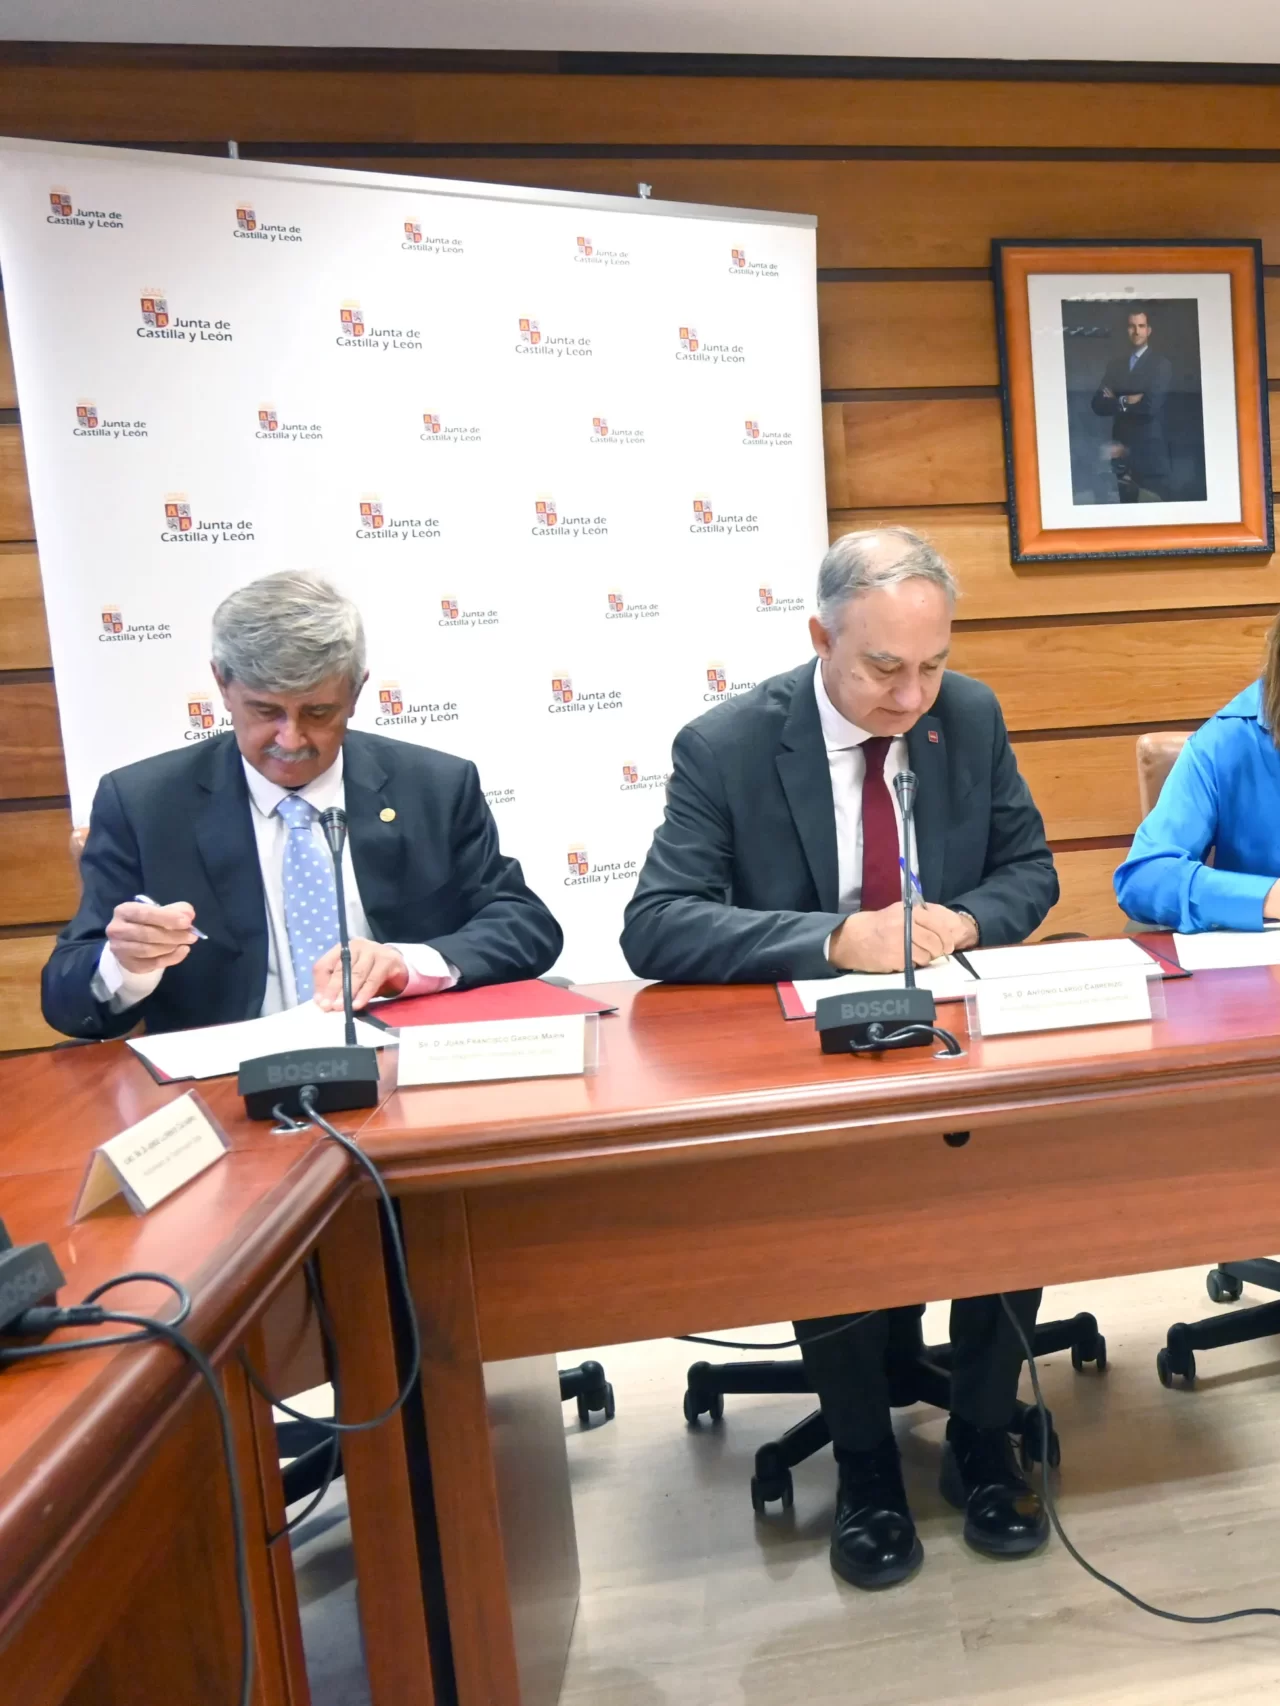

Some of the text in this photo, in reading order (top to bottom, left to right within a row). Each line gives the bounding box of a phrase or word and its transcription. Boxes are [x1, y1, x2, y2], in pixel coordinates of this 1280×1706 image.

[75, 208, 121, 219] Junta de
[46, 215, 85, 226] Castilla
[97, 219, 123, 228] León
[259, 223, 300, 233] Junta de
[233, 229, 268, 239] Castilla
[278, 233, 302, 242] León
[424, 236, 449, 244] Junta
[400, 242, 432, 251] Castilla
[442, 245, 463, 253] León
[595, 249, 617, 257] Junta
[573, 255, 602, 264] Castilla
[747, 261, 767, 269] Junta
[728, 266, 754, 275] Castilla
[173, 317, 230, 329] Junta de
[136, 327, 185, 339] Castilla
[200, 330, 232, 341] León
[368, 327, 420, 338] Junta de
[335, 336, 379, 347] Castilla
[392, 339, 422, 349] León
[544, 335, 591, 346] Junta de
[514, 344, 554, 354] Castilla
[566, 346, 592, 356] León
[701, 343, 743, 353] Junta de
[675, 351, 710, 361] Castilla
[721, 353, 745, 362] León
[101, 419, 146, 428] Junta de
[280, 423, 307, 431] Junta
[73, 428, 111, 436] Castilla
[122, 428, 148, 436] León
[255, 431, 289, 439] Castilla
[299, 431, 323, 439] León
[419, 433, 451, 441] Castilla
[589, 435, 617, 443] Castilla
[387, 518, 439, 527] Junta de
[560, 516, 606, 524] Junta de
[715, 514, 757, 522] Junta de
[196, 520, 252, 529] Junta de
[689, 524, 724, 533] Castilla
[735, 524, 759, 532] León
[355, 529, 398, 539] Castilla
[411, 528, 440, 537] León
[531, 526, 570, 536] Castilla
[581, 526, 608, 534] León
[160, 532, 208, 542] Castilla
[222, 531, 254, 541] León
[605, 611, 632, 619] Castilla
[438, 618, 469, 626] Castilla
[126, 624, 154, 632] Junta
[98, 633, 135, 642] Castilla
[730, 682, 757, 690] Junta
[576, 690, 621, 701] Junta de
[406, 701, 457, 713] Junta de
[547, 703, 585, 713] Castilla
[597, 701, 622, 709] León
[374, 715, 417, 726] Castilla
[430, 713, 458, 722] León
[620, 782, 647, 791] Castilla
[591, 860, 636, 872] Junta de
[563, 874, 601, 886] Castilla
[612, 870, 637, 880] León
[840, 998, 909, 1019] BOSCH
[267, 1059, 349, 1083] BOSCH
[0, 1260, 49, 1306] OSCH
